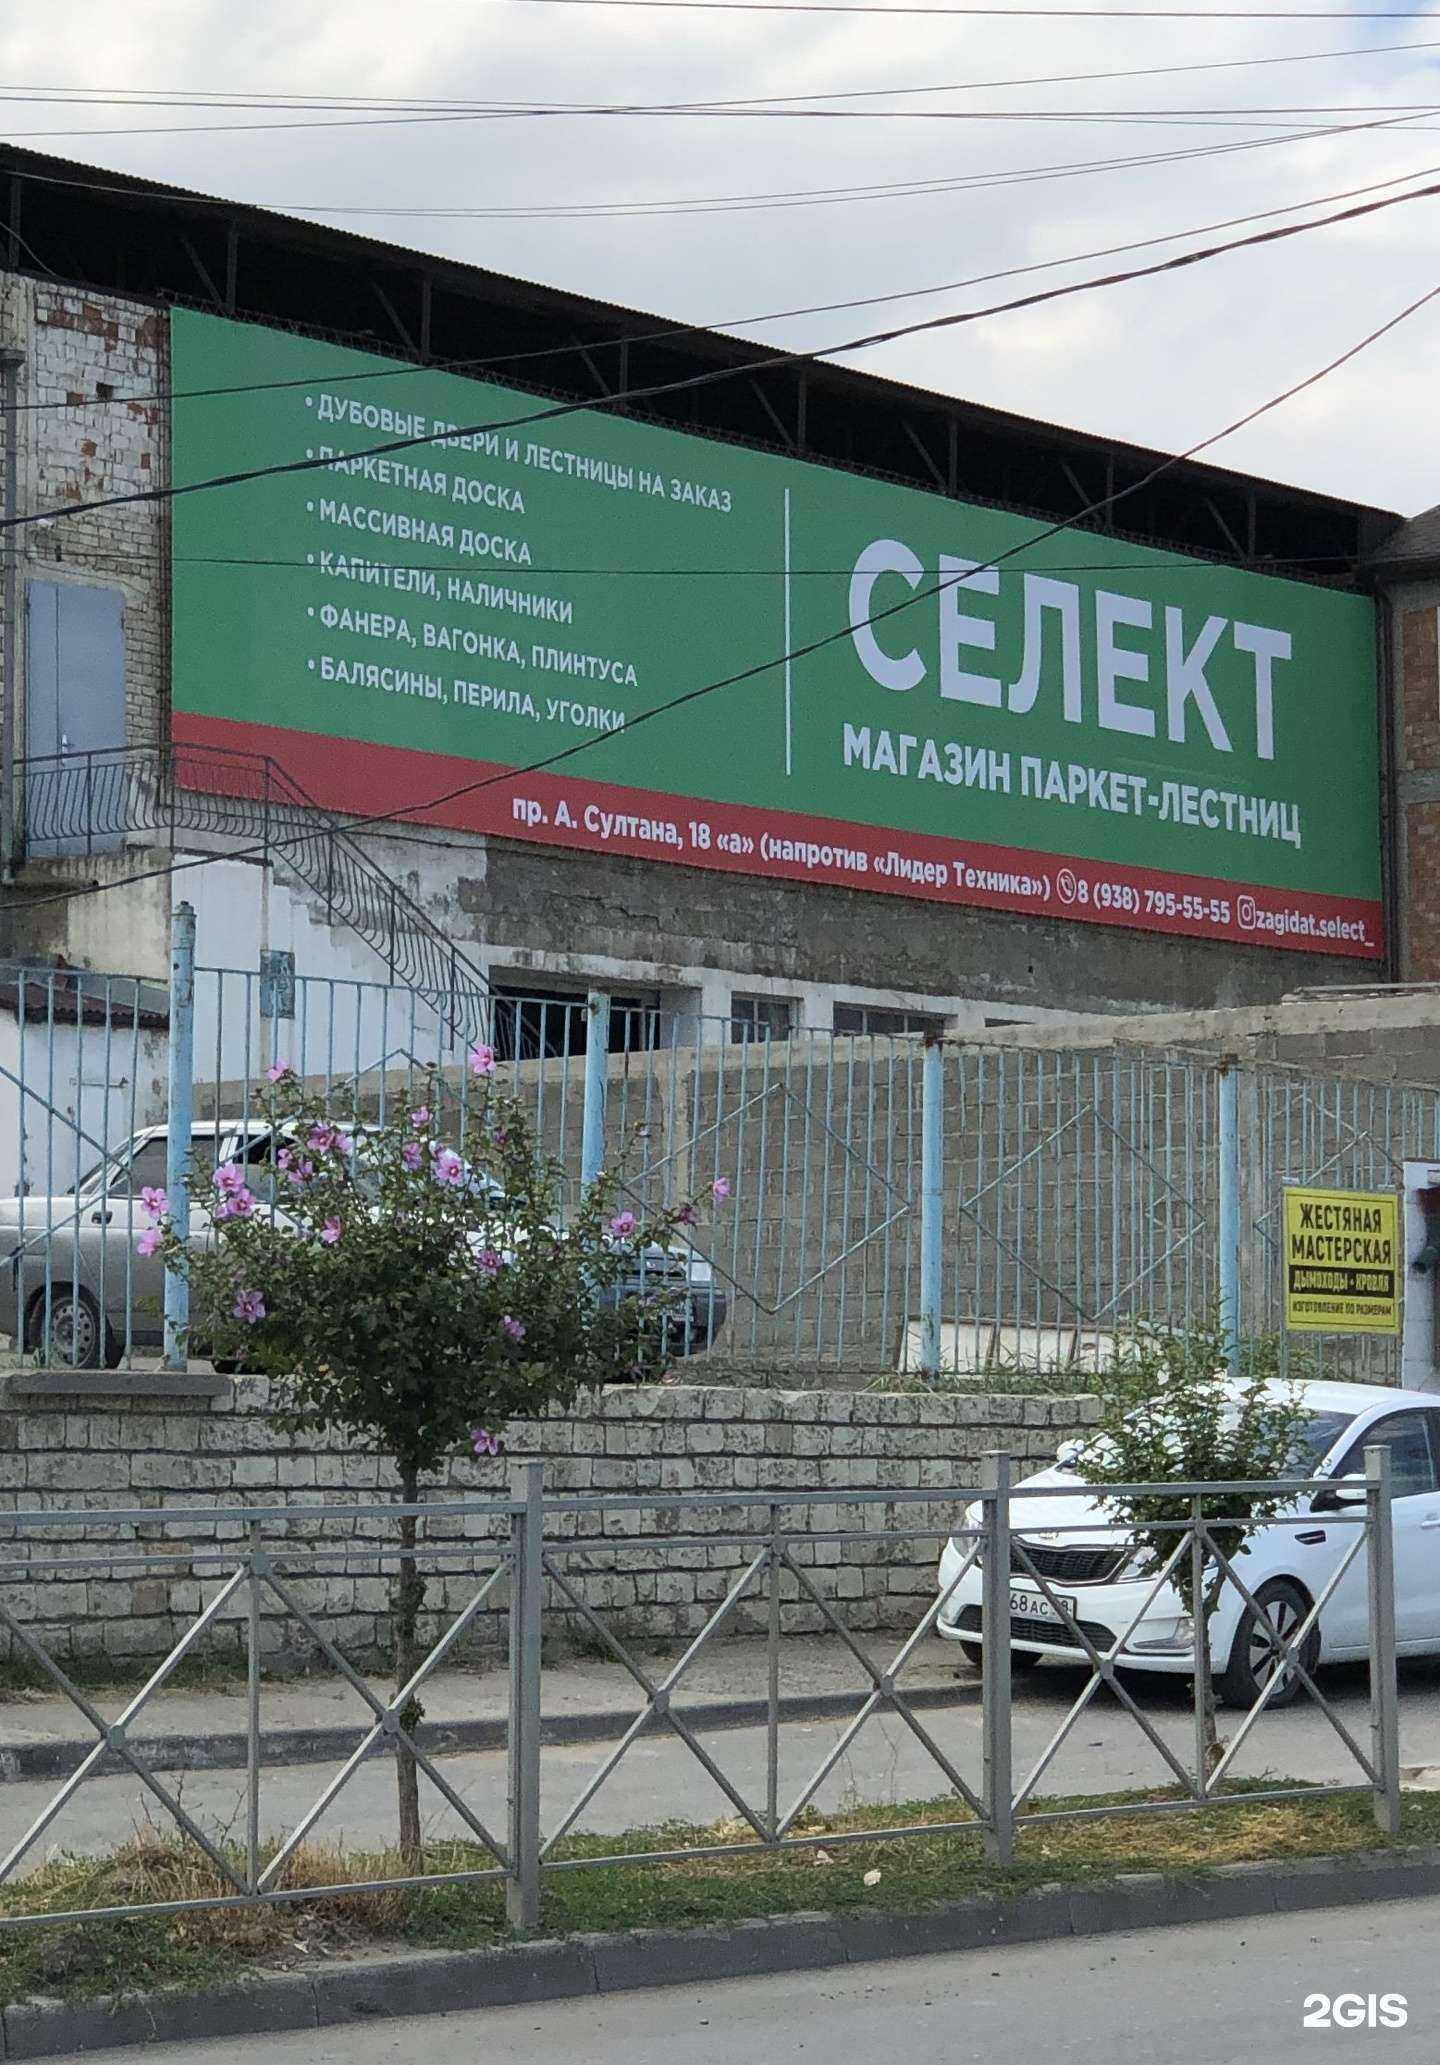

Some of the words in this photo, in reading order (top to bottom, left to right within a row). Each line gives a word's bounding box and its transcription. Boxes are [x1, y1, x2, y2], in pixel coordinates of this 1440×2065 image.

[318, 394, 425, 438] ДУБОВЫЕ
[431, 420, 499, 457] ДВЕРИ
[505, 438, 519, 462] И
[524, 444, 633, 490] ЛЕСТНИЦЫ
[639, 470, 665, 497] НА
[670, 478, 732, 513] ЗАКАЗ
[319, 446, 447, 496] ПАРКЕТНАЯ
[452, 476, 526, 514] ДОСКА
[320, 498, 454, 548] МАССИВНАЯ
[459, 529, 532, 565] ДОСКА
[320, 550, 441, 601] КАПИТЕЛИ,
[448, 577, 573, 624] НАЛИЧНИКИ
[320, 604, 416, 648] ФАНЕРА,
[423, 624, 526, 668] ВАГОНКА,
[532, 645, 638, 687] ПЛИНТУСА
[848, 538, 1292, 760] СЕЛЕКТ
[321, 656, 448, 704] БАЛЯСИНЫ,
[454, 679, 541, 722] ПЕРИЛА,
[546, 698, 626, 734] УГОЛКИ
[843, 723, 1010, 793] МАГАЗИН
[1021, 756, 1301, 849] ПАРКЕТ-ЛЕСТНИЦ
[512, 798, 548, 828] пр.
[554, 801, 577, 829] А.
[584, 805, 683, 850] Султана,
[689, 821, 711, 849] 18
[716, 832, 754, 854] «а»
[760, 832, 868, 872] (напротив
[873, 851, 948, 888] «Лидер
[953, 861, 1051, 901] Техника»)
[1077, 879, 1089, 903] 8
[1093, 882, 1139, 914] (938)
[1145, 890, 1230, 924] 795-55-55
[1291, 1234, 1391, 1264] МАСТЕРСКАЯ
[1299, 1203, 1382, 1233] ЖЕСТЯНАЯ
